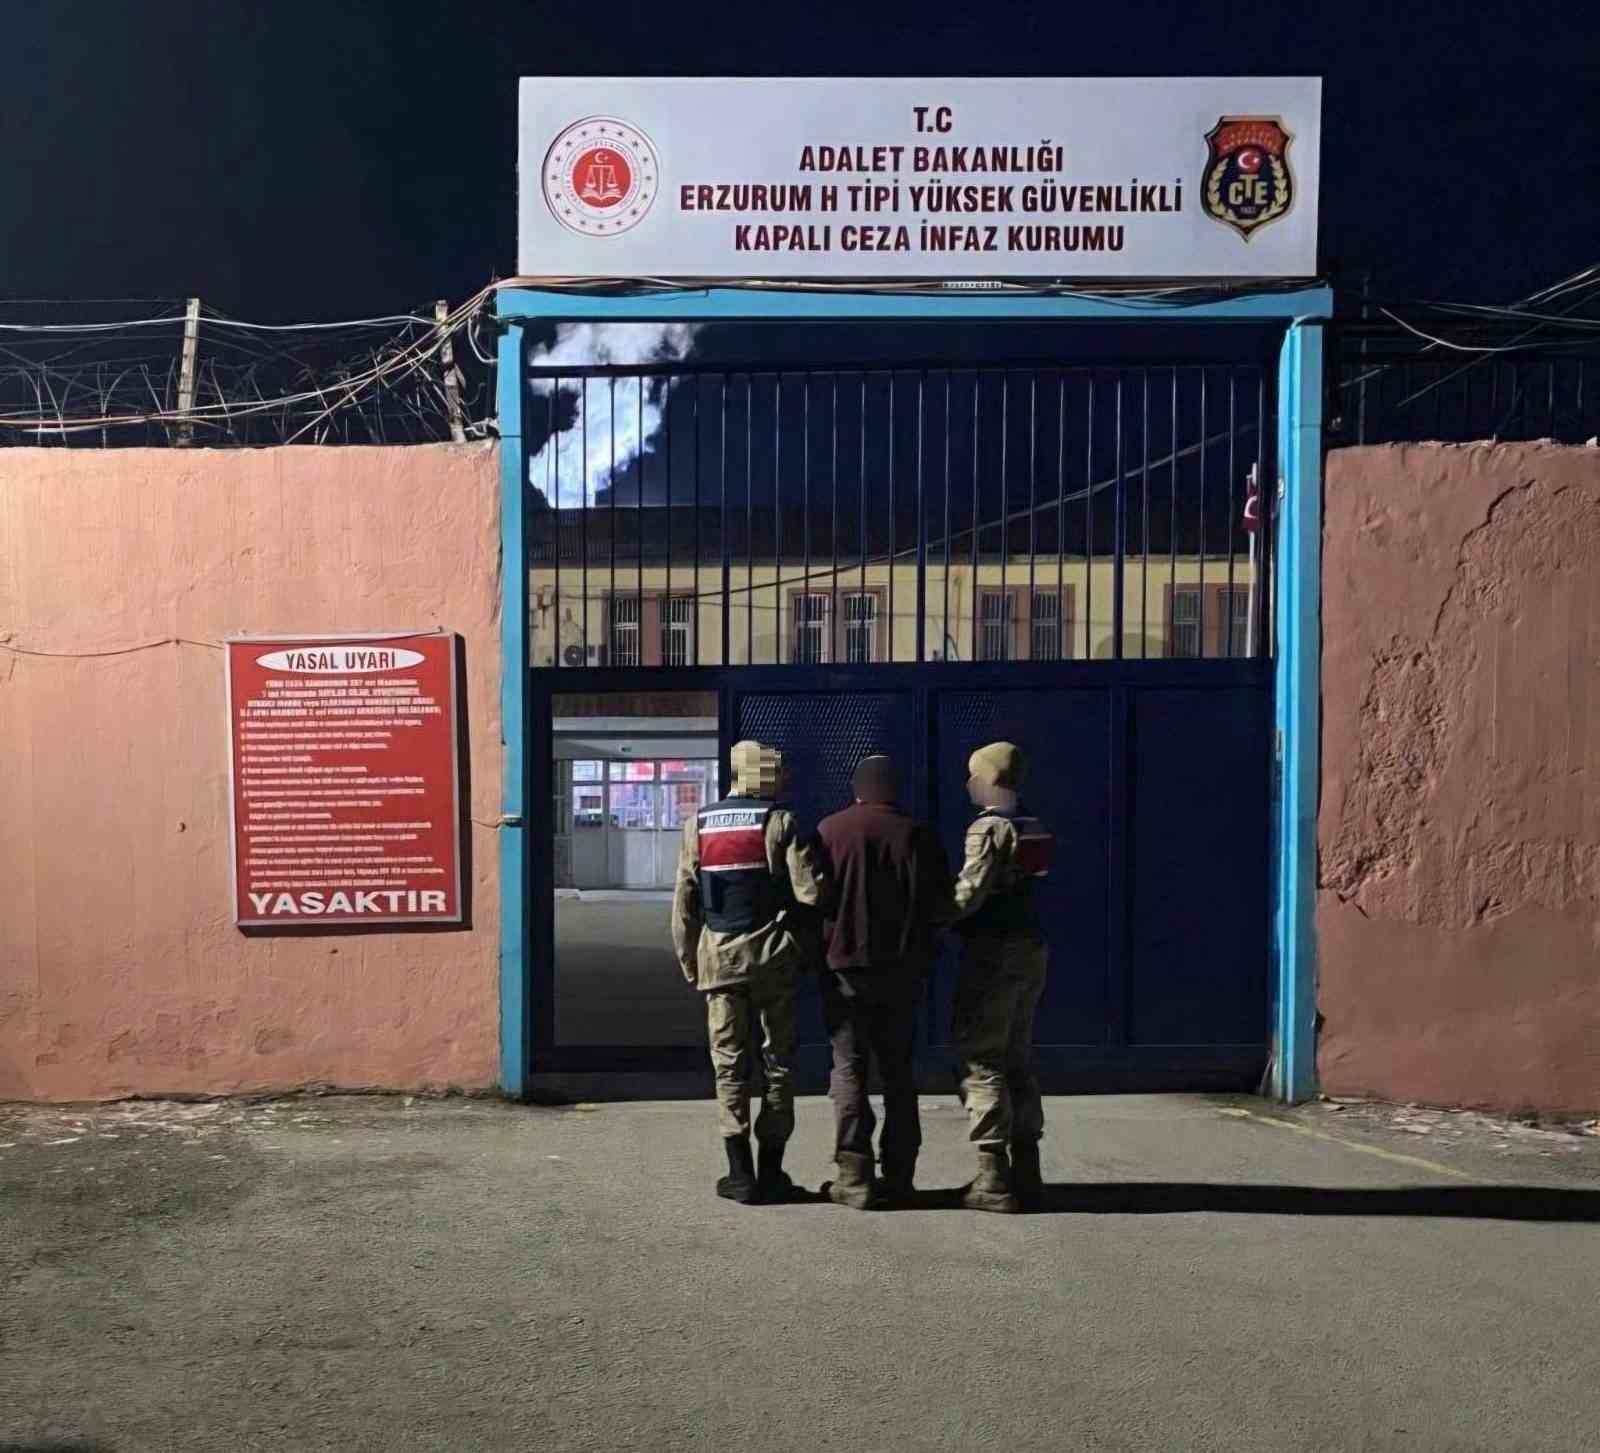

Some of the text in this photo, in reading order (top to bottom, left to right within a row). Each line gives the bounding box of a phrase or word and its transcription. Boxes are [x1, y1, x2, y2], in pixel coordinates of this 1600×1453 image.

[914, 107, 953, 133] T.C
[799, 140, 1064, 173] ADALET BAKANLIĞI
[680, 178, 1183, 213] ERZURUM H TİPİ YÜKSEK GÜVENLİKLİ
[736, 219, 1124, 252] KAPALI CEZA İNFAZ KURUMU
[286, 652, 396, 670] YASAL UYARI
[248, 890, 447, 915] YASAKTIR
